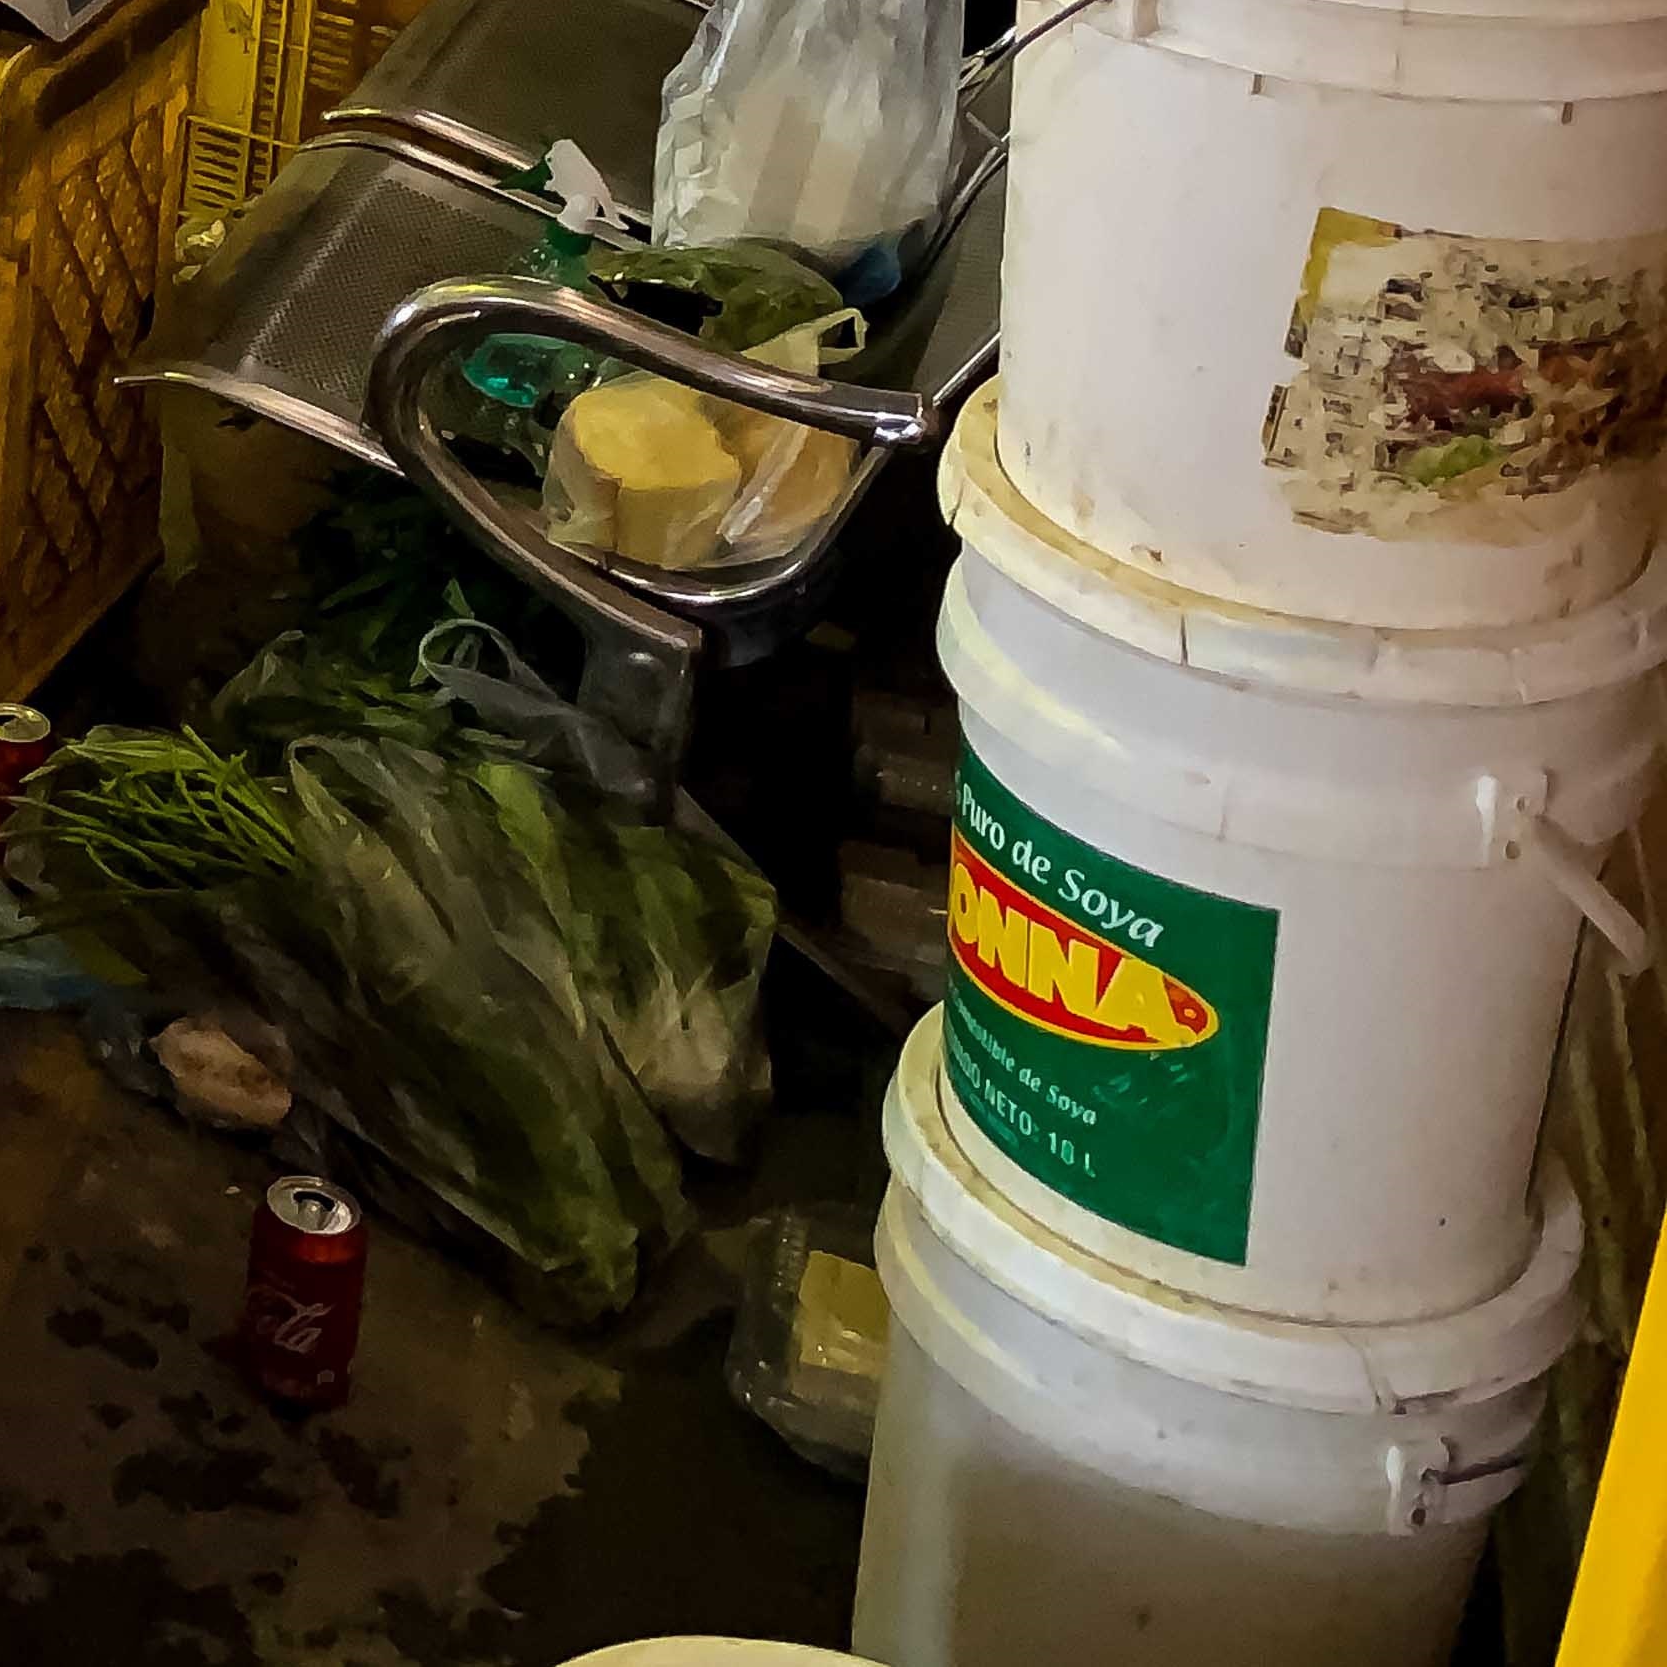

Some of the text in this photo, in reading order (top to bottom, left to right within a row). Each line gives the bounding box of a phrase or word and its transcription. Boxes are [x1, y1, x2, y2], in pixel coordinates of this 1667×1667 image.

[962, 782, 1006, 851] Puro
[1011, 840, 1052, 885] de
[1058, 868, 1164, 948] Soya
[1019, 1067, 1041, 1093] de
[1046, 1084, 1097, 1125] Soya
[1049, 1131, 1075, 1165] 10
